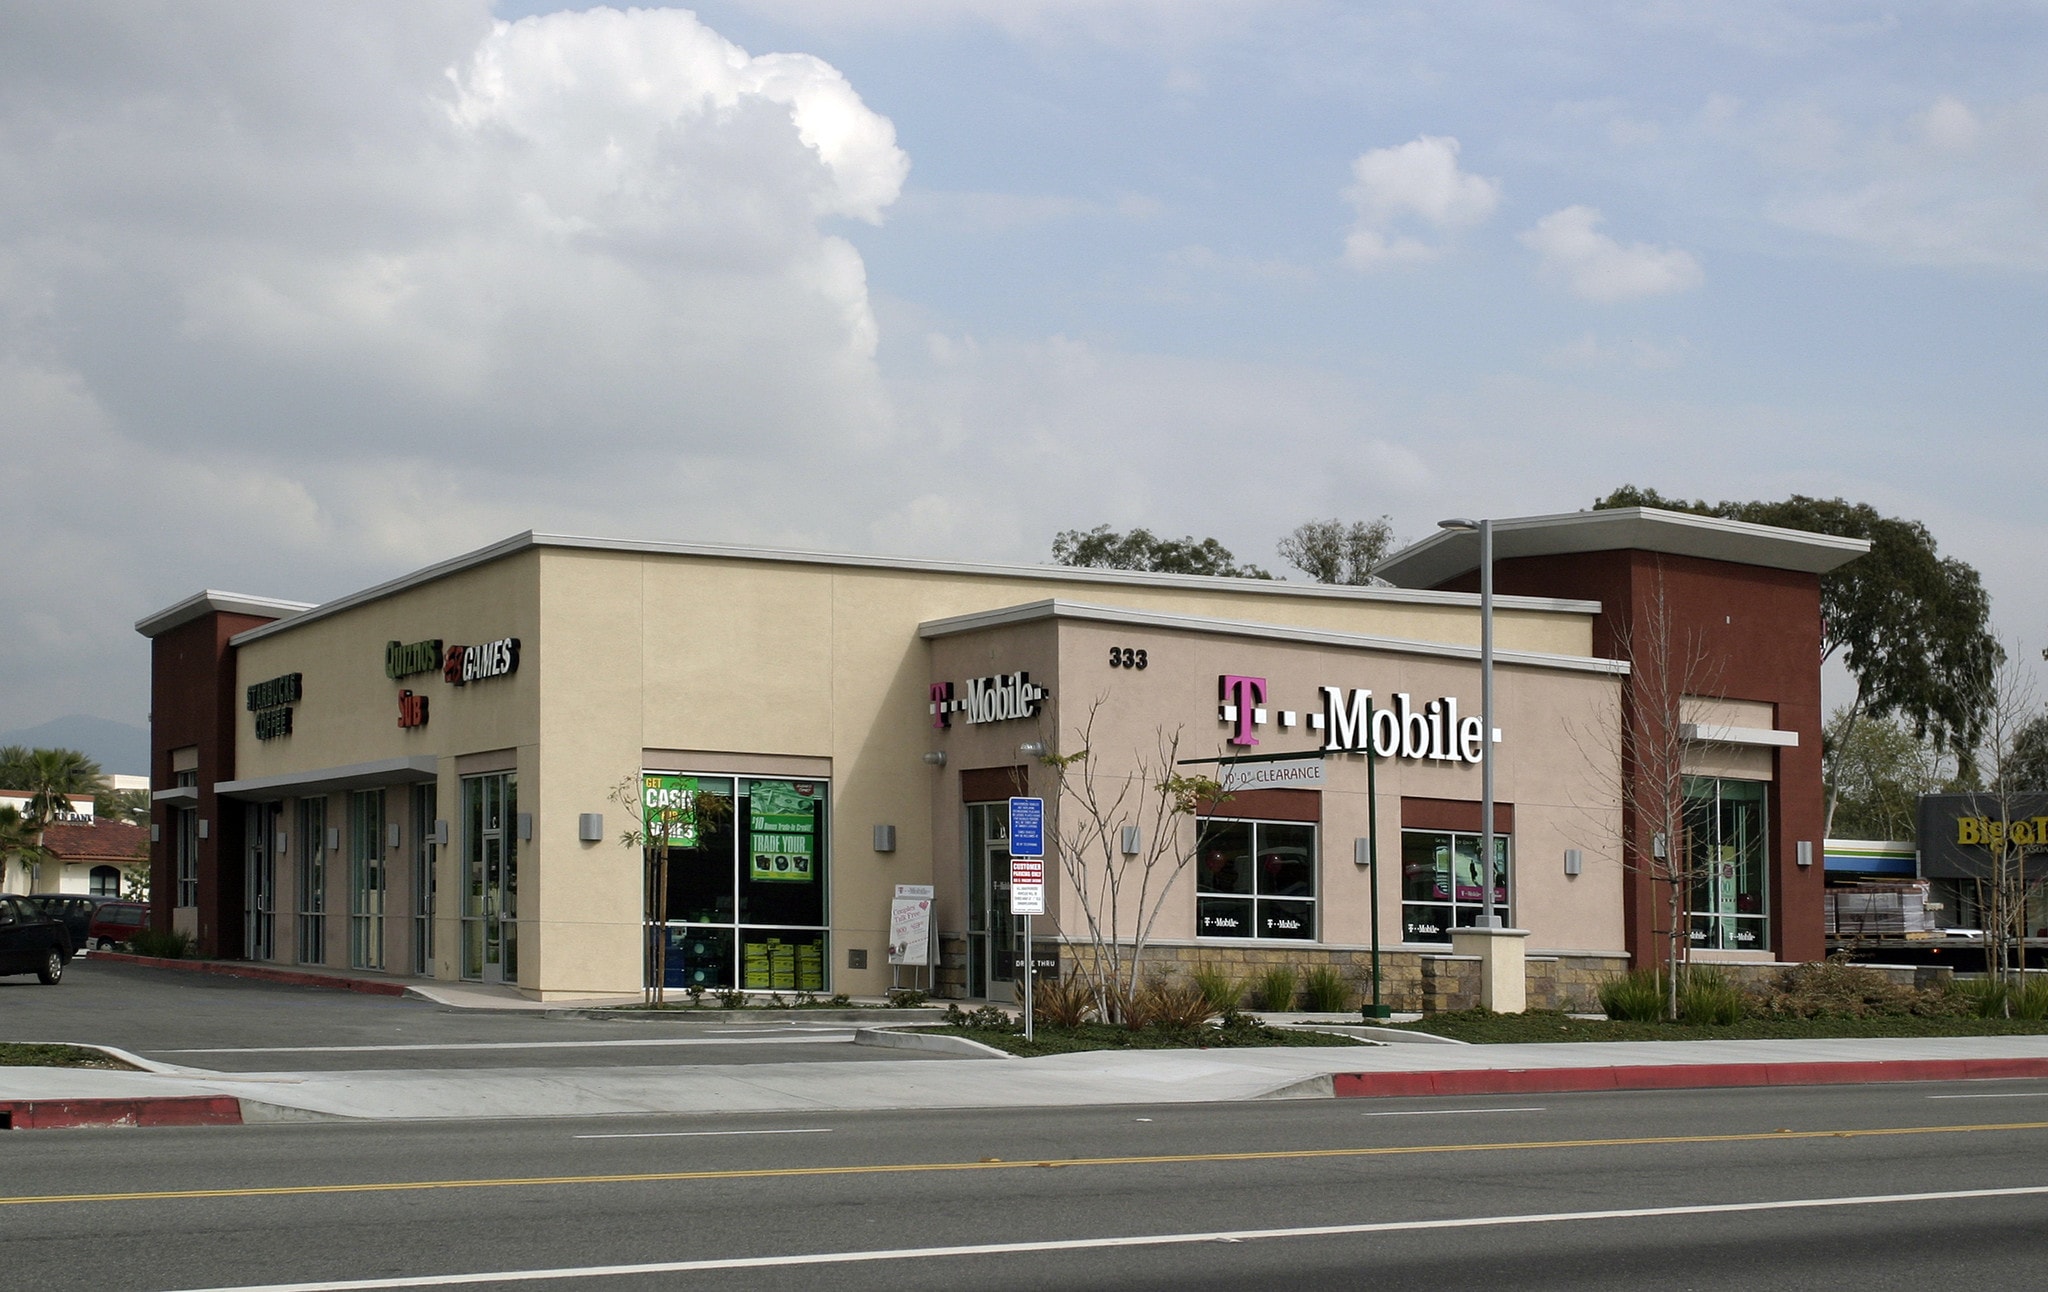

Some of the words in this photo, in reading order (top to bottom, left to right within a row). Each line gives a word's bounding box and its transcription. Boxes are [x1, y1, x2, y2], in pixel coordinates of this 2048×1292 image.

[463, 637, 515, 681] GAMES
[1109, 646, 1148, 670] 333
[398, 689, 426, 728] SUB
[646, 777, 662, 788] GET
[1256, 766, 1320, 783] CLEARANCE
[753, 834, 780, 853] TRADE
